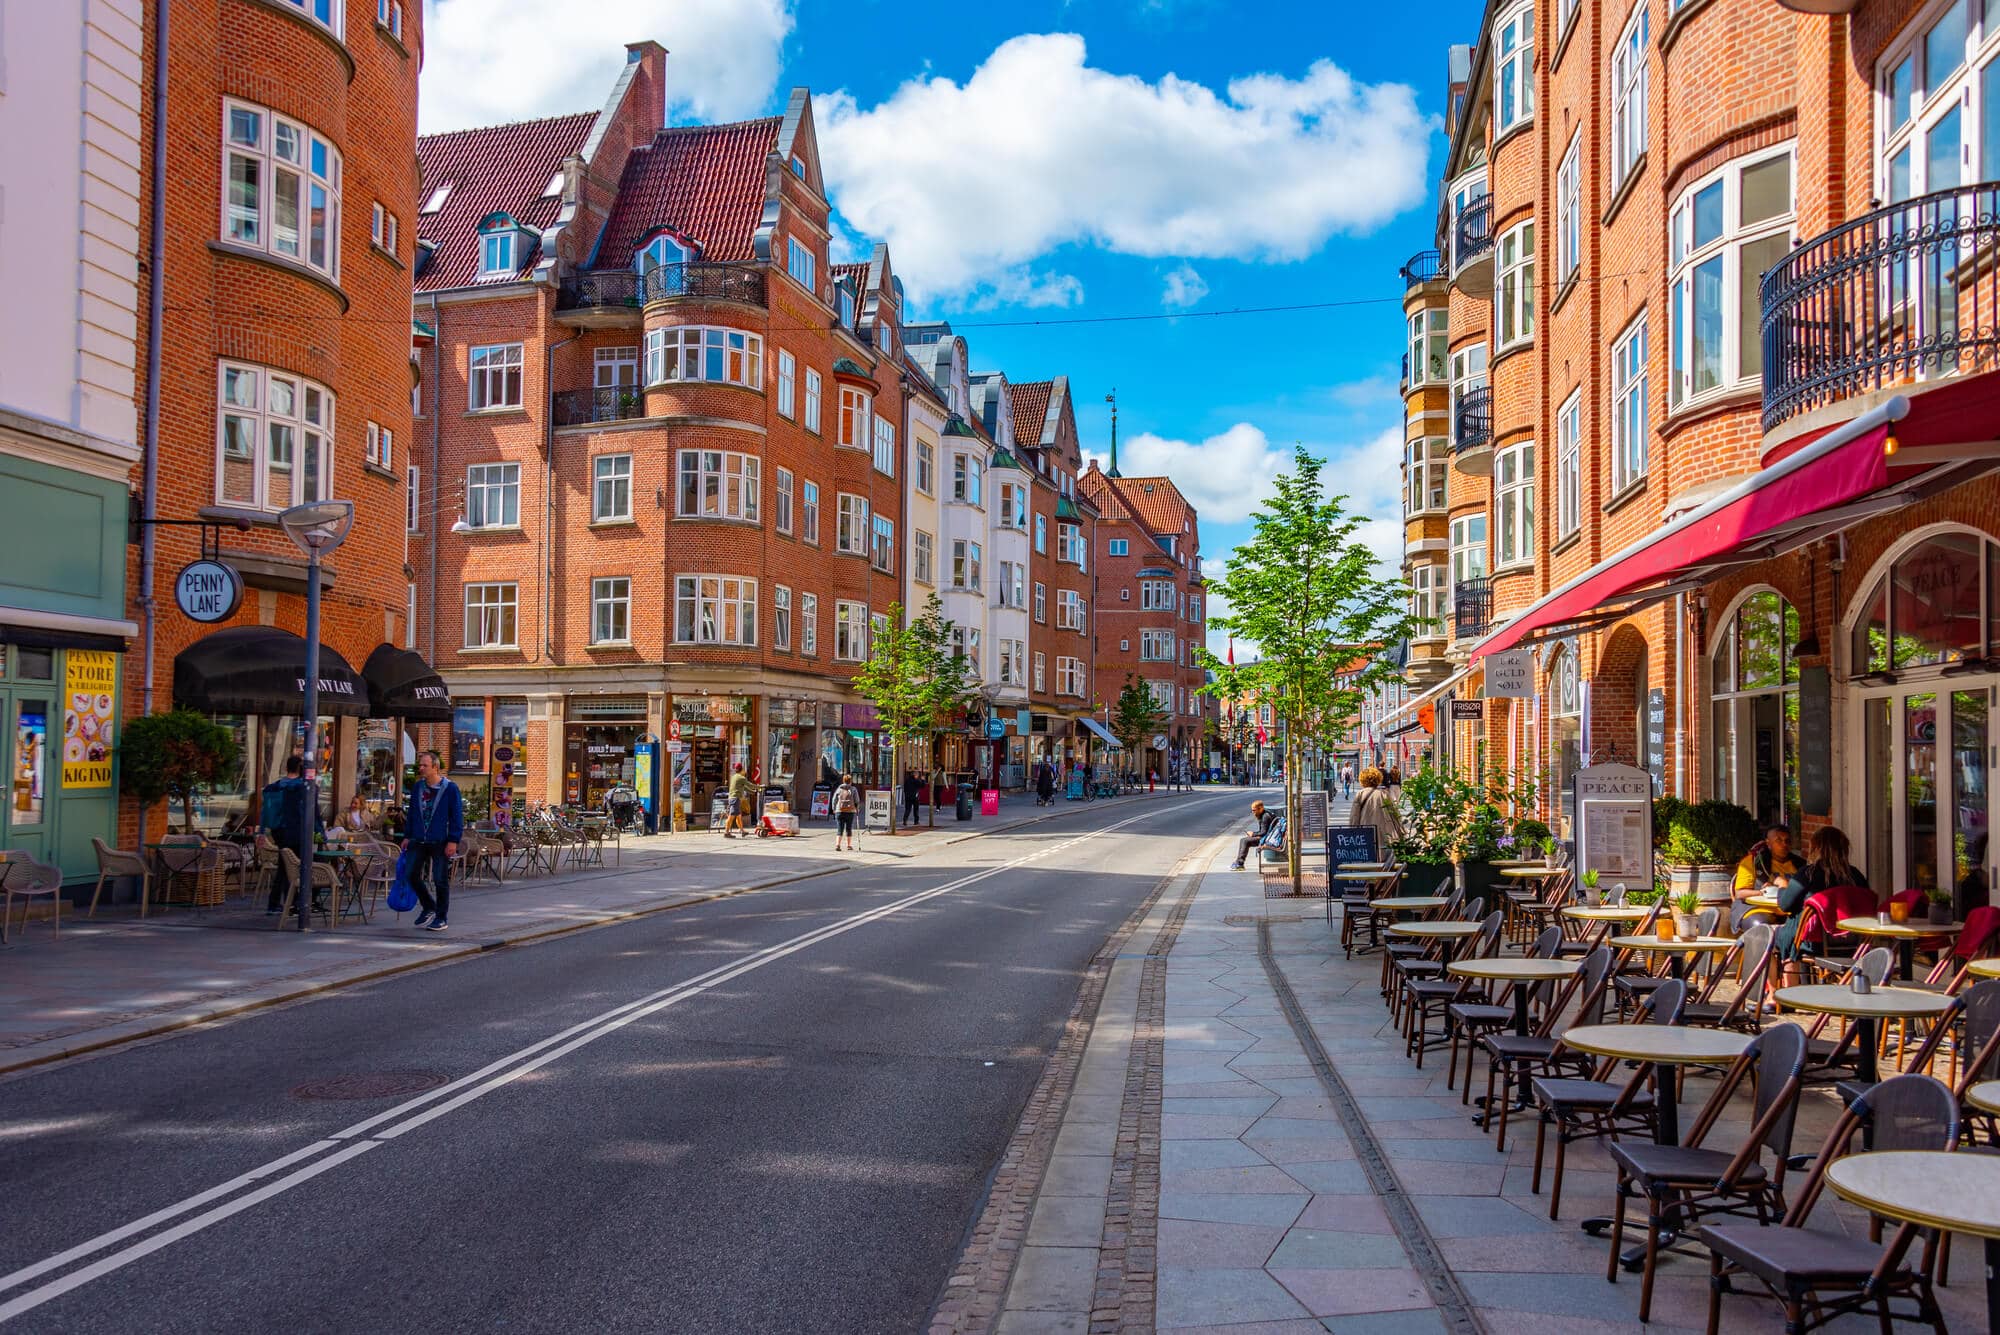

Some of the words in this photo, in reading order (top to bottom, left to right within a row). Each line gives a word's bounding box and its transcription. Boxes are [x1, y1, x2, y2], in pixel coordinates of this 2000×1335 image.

[185, 574, 225, 592] PENNY
[190, 595, 221, 613] LANE
[68, 665, 113, 681] STORE
[1495, 669, 1525, 677] GULD
[1497, 681, 1523, 689] SØLV
[1453, 702, 1481, 711] FRISØR
[64, 768, 87, 783] KIG
[89, 767, 111, 782] IND
[1582, 783, 1645, 794] PEACE
[1337, 834, 1367, 846] PEACE
[1336, 849, 1369, 861] BRUNCH
